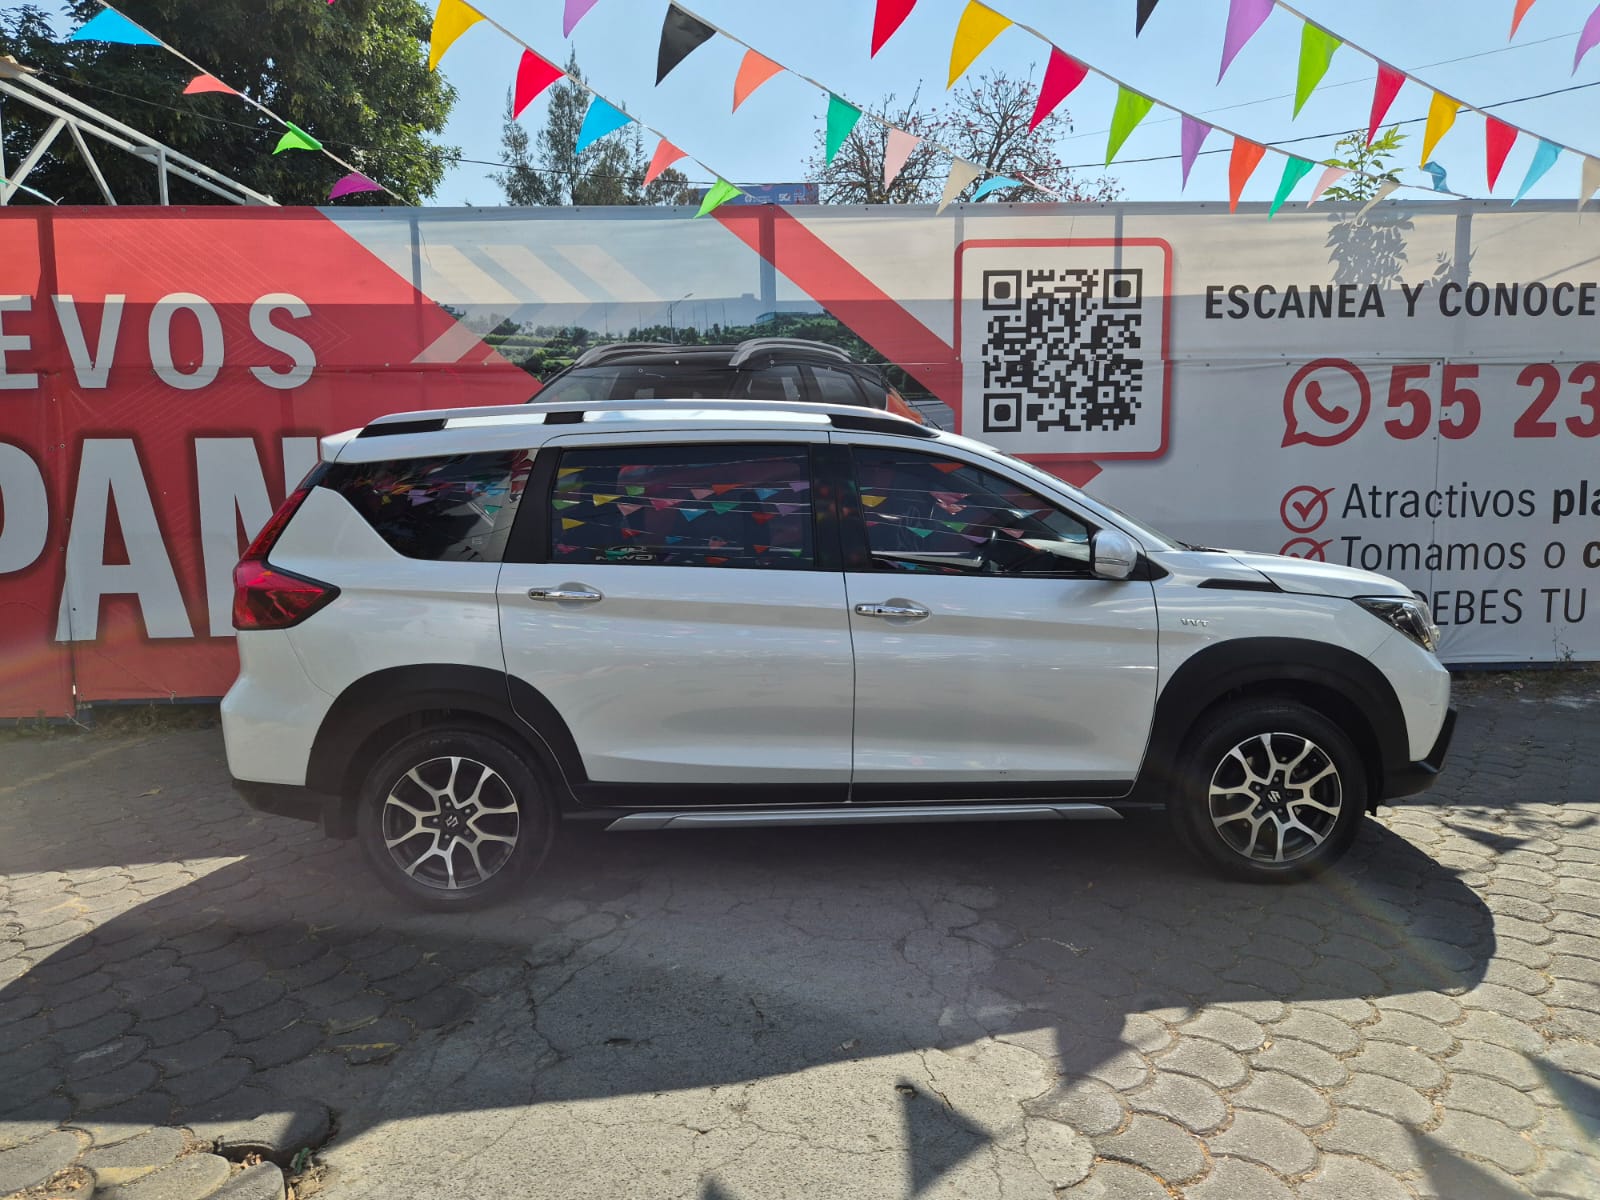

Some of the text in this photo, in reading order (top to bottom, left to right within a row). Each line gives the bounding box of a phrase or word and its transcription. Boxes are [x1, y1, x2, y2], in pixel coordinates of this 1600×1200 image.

[1205, 281, 1597, 319] ESCANEA Y CONOCE
[0, 293, 317, 390] EVOS
[1384, 361, 1600, 440] 55 23
[1341, 482, 1536, 519] Atractivos
[1340, 535, 1527, 571] Tomamos
[1543, 541, 1566, 569] o
[1411, 587, 1587, 626] EBES TU
